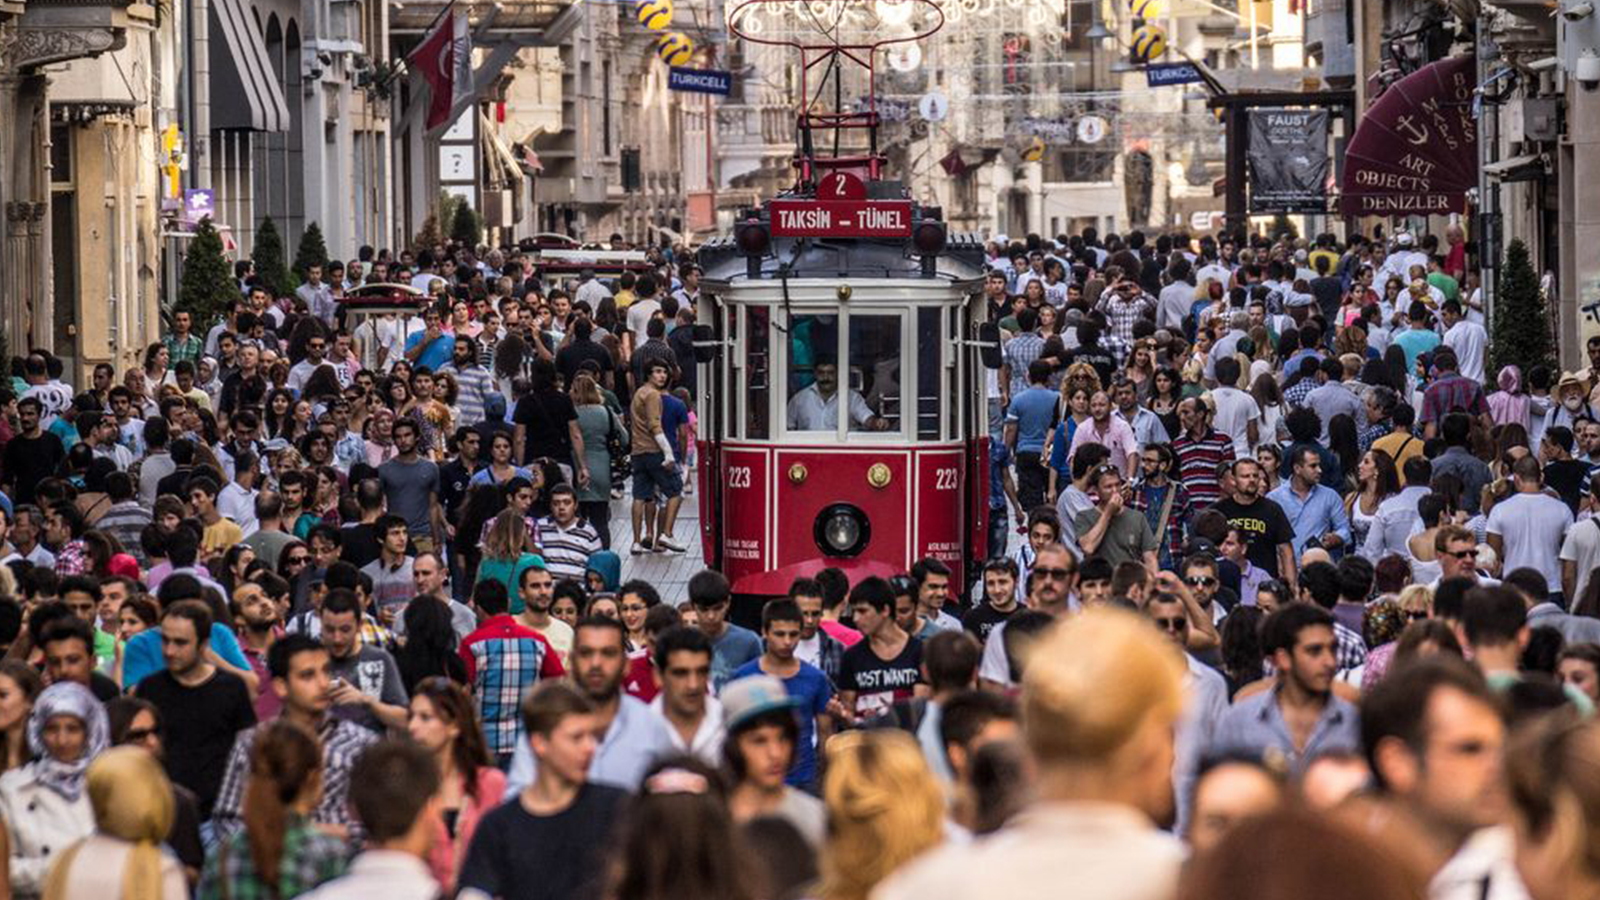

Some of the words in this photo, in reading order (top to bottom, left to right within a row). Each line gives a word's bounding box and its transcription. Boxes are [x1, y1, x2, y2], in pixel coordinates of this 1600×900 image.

[671, 72, 728, 89] TURKCELL
[1453, 72, 1475, 143] BOOKS
[1267, 114, 1309, 126] FAUST
[1421, 96, 1458, 150] MAPS
[1398, 153, 1436, 177] ART
[835, 174, 846, 196] 2
[1355, 169, 1431, 192] OBJECTS
[1361, 192, 1449, 211] DENİZLER
[857, 207, 907, 230] TÜNEL
[728, 466, 751, 488] 223
[936, 467, 958, 490] 223
